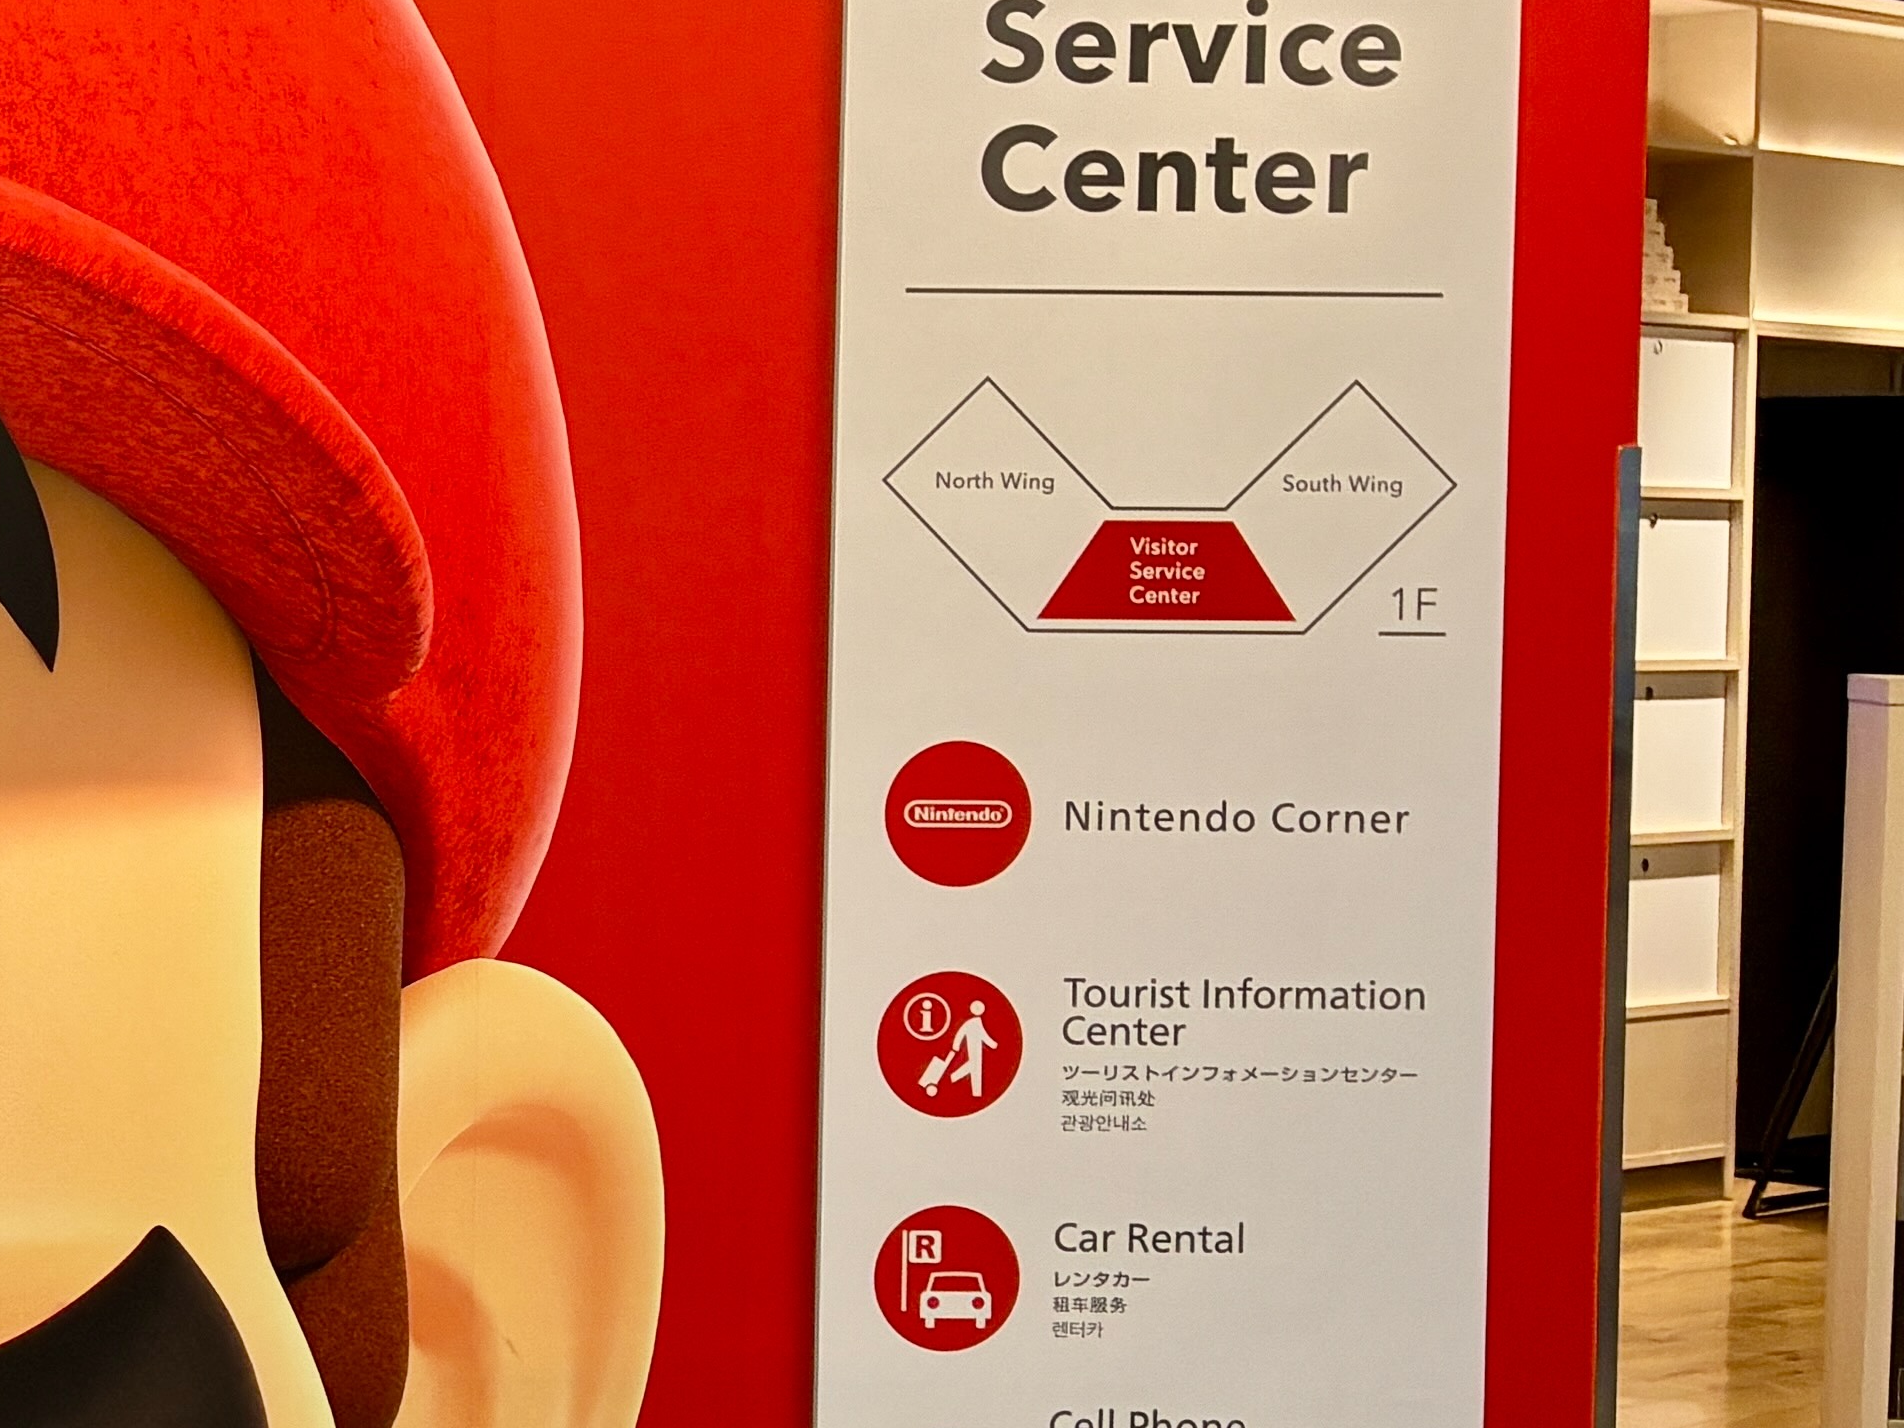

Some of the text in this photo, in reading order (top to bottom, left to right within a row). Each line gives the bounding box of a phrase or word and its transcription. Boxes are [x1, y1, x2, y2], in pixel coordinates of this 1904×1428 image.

[980, 123, 1369, 215] Center
[935, 470, 1055, 495] North Wing
[1282, 473, 1403, 499] South Wing
[1129, 536, 1199, 556] Visitor
[1129, 560, 1206, 581] Service
[1129, 585, 1201, 605] Center
[1392, 587, 1438, 621] 1F
[1065, 799, 1410, 834] Nintendo Corner
[1063, 976, 1425, 1011] Tourist Information
[1062, 1015, 1187, 1047] Center
[1062, 1064, 1418, 1084] ツーリストインフォメーションセンター
[1061, 1089, 1156, 1108] 观光问讯处
[1061, 1114, 1148, 1133] 관광안내소
[914, 1234, 937, 1260] R
[1054, 1221, 1244, 1254] Car Rental
[1054, 1271, 1151, 1288] レンタカー
[1052, 1296, 1128, 1314] 租车服务
[1051, 1320, 1104, 1339] 렌터카
